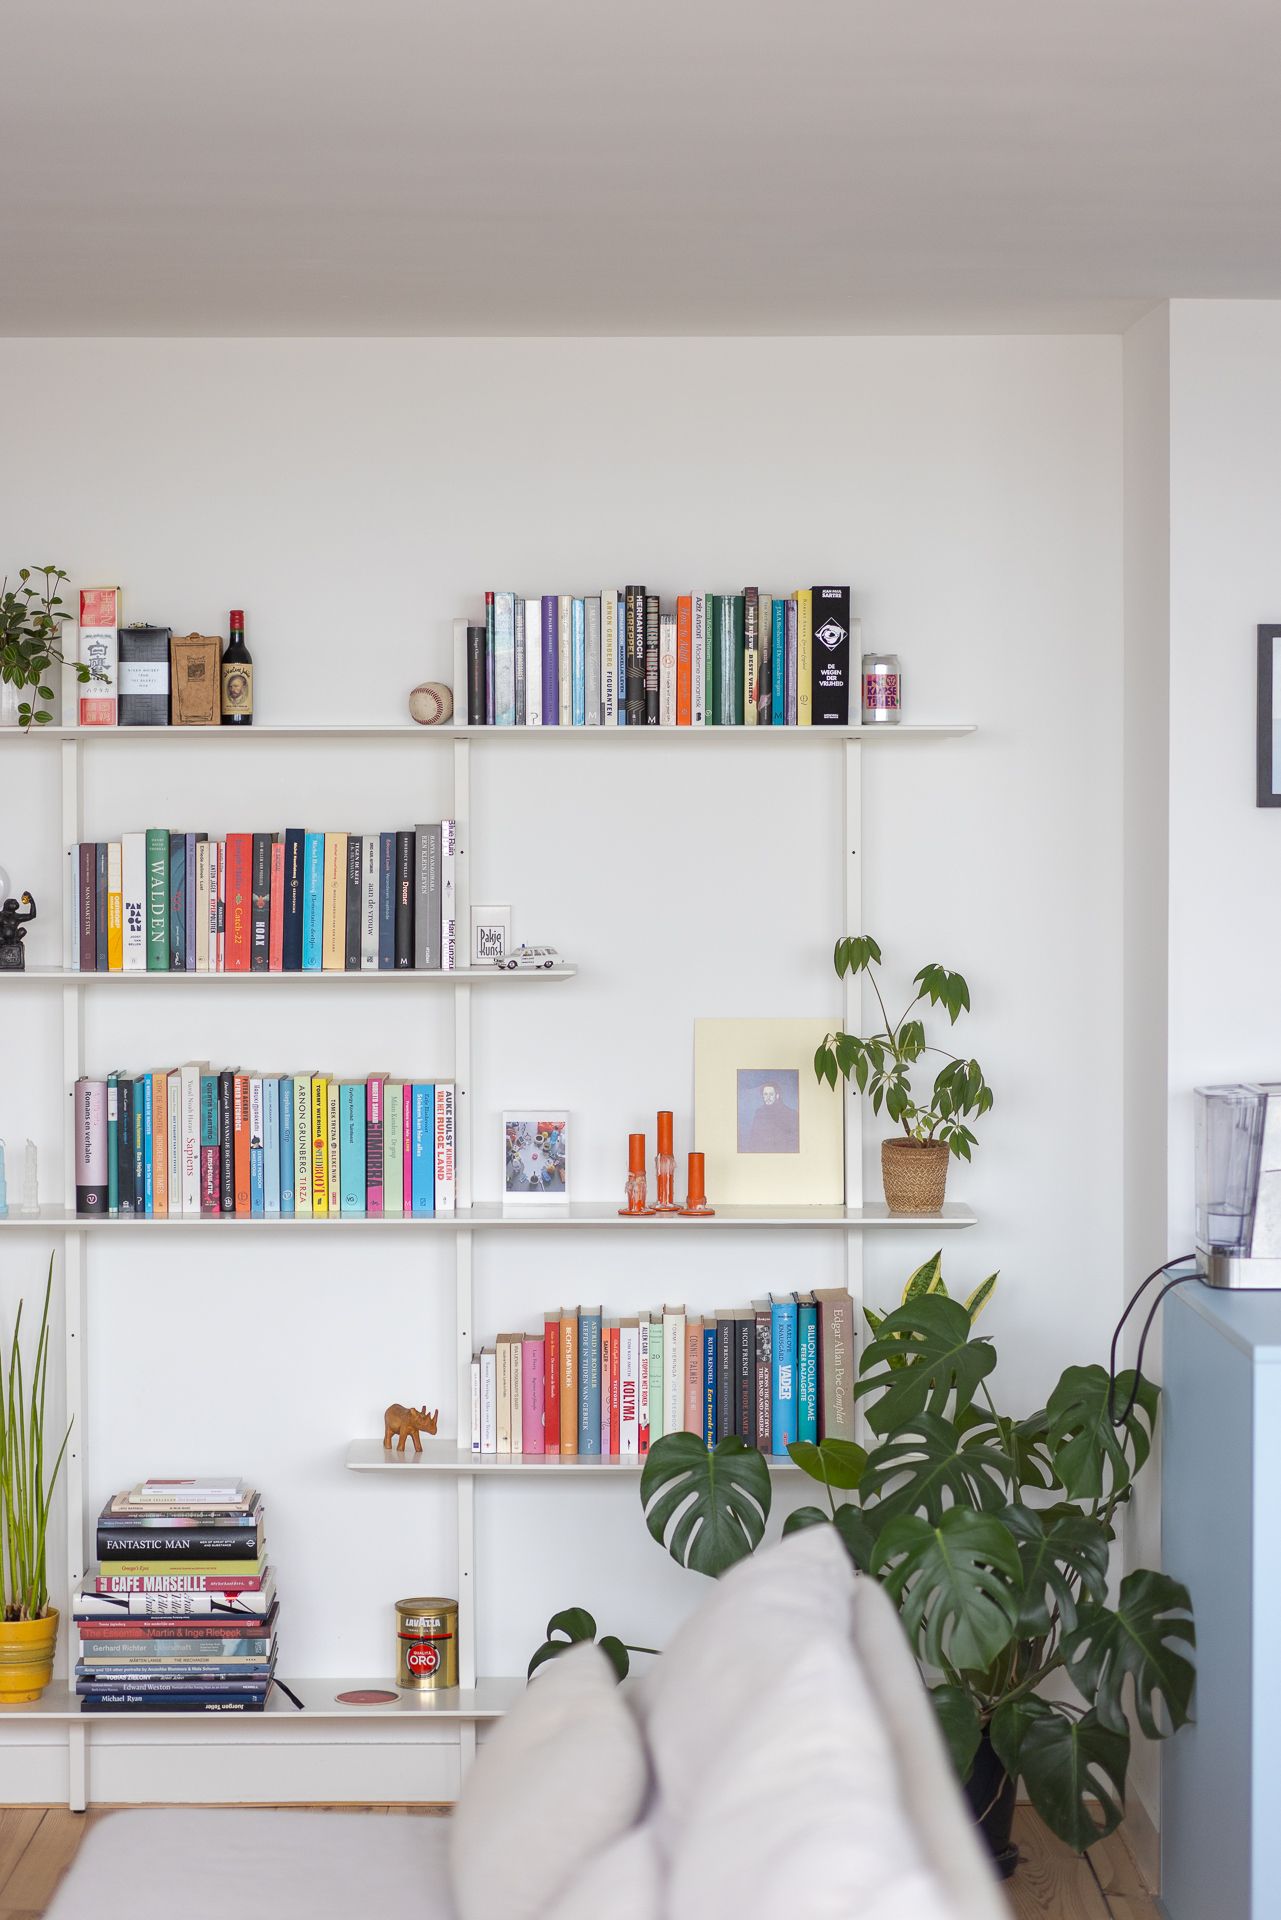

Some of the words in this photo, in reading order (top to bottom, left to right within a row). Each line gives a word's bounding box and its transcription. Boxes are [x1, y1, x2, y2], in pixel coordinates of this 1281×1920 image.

[627, 596, 633, 609] DE
[151, 859, 164, 943] WALDEN
[368, 899, 375, 908] de
[255, 921, 265, 946] HOAX
[480, 928, 501, 945] Pakje
[480, 942, 503, 956] Kunst
[85, 1122, 90, 1130] en
[184, 1138, 195, 1176] Sapiens
[367, 1121, 382, 1187] GOMORRA
[831, 1309, 843, 1338] Edgar
[834, 1339, 843, 1366] Allan
[781, 1365, 791, 1400] VADER
[835, 1368, 844, 1386] Poe
[833, 1386, 845, 1424] Compleet
[106, 1540, 162, 1550] FANTASTIC
[165, 1540, 190, 1549] MAN
[112, 1577, 139, 1591] CAFE
[143, 1576, 206, 1591] MARSEILLE
[406, 1617, 440, 1628] LAVAZZA
[410, 1656, 435, 1665] ORO
